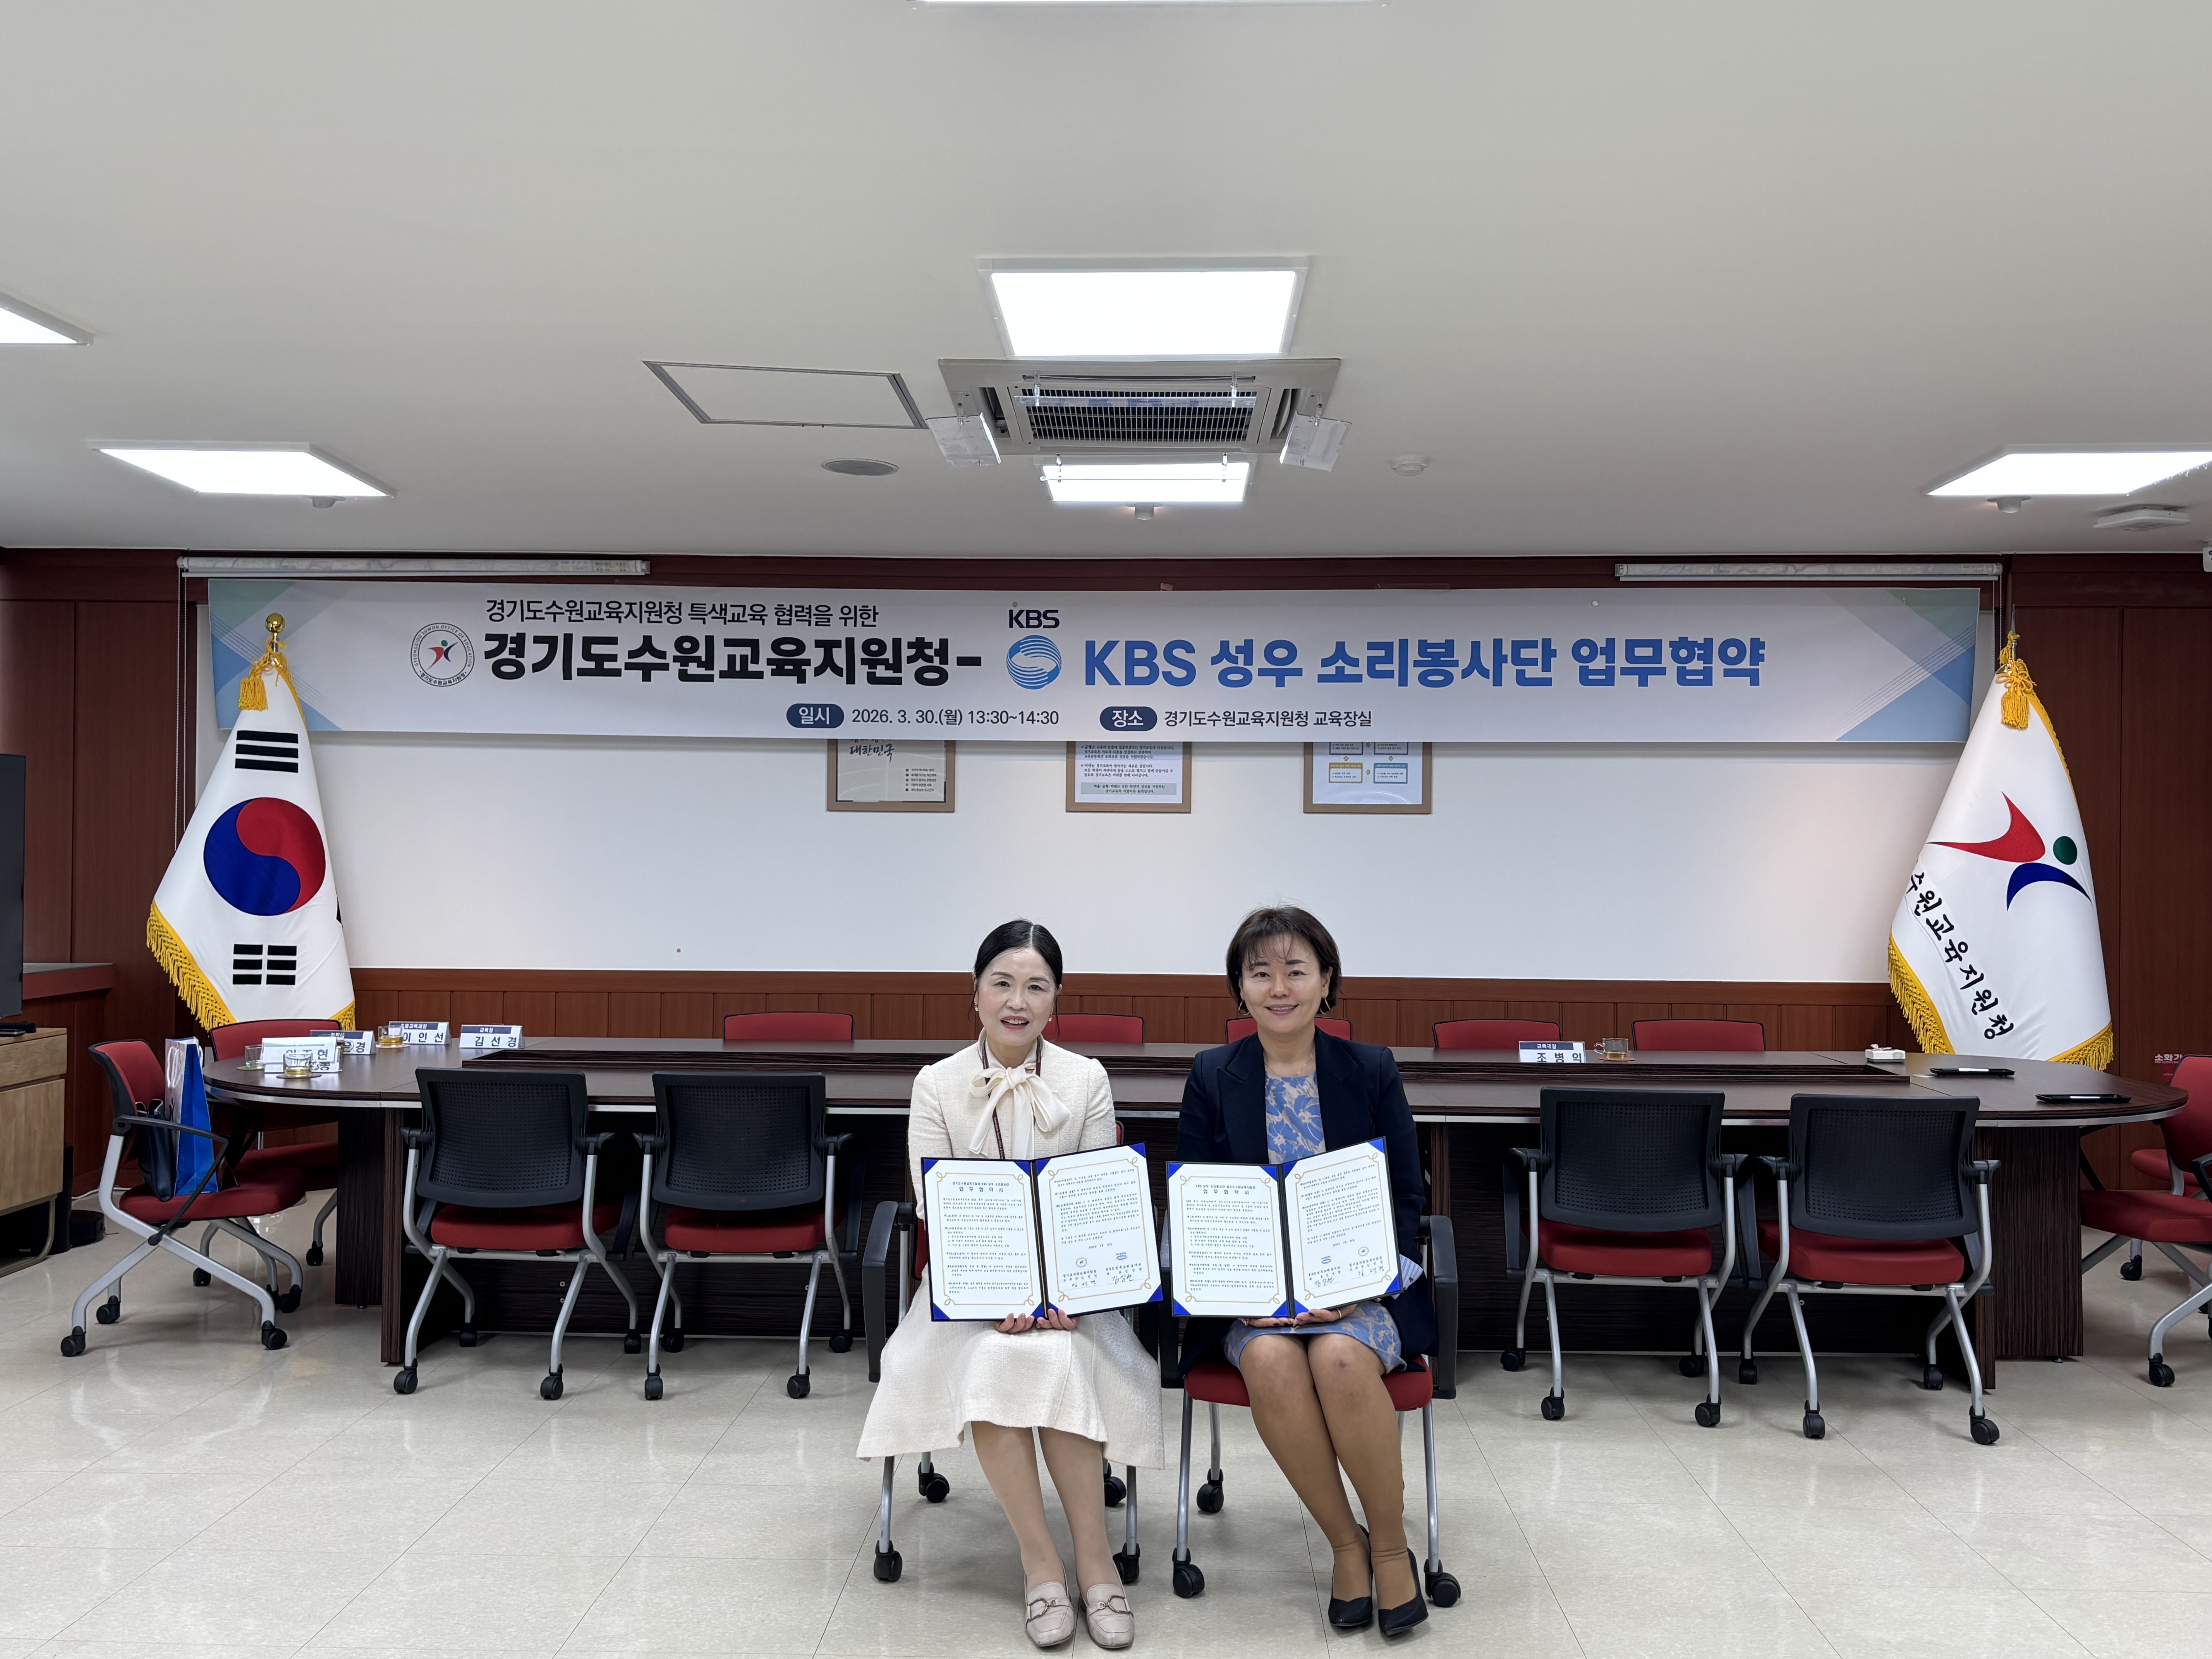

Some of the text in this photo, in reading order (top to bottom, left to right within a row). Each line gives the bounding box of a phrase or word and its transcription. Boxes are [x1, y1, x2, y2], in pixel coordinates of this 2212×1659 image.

[486, 599, 879, 627] 경기도수원교육지원청 특색교육 협력을 위한
[1009, 610, 1060, 629] KBS
[1085, 640, 1196, 687] KBS
[1211, 639, 1303, 687] 성우
[1317, 638, 1557, 688] 소리봉사단
[1571, 637, 1766, 687] 업무협약
[799, 708, 1059, 726] 일시 2026. 3. 30.(월) 13:30~14:30
[1112, 709, 1371, 727] 장소 경기도수원교육지원청 교육장실
[850, 743, 895, 763] 대한민국
